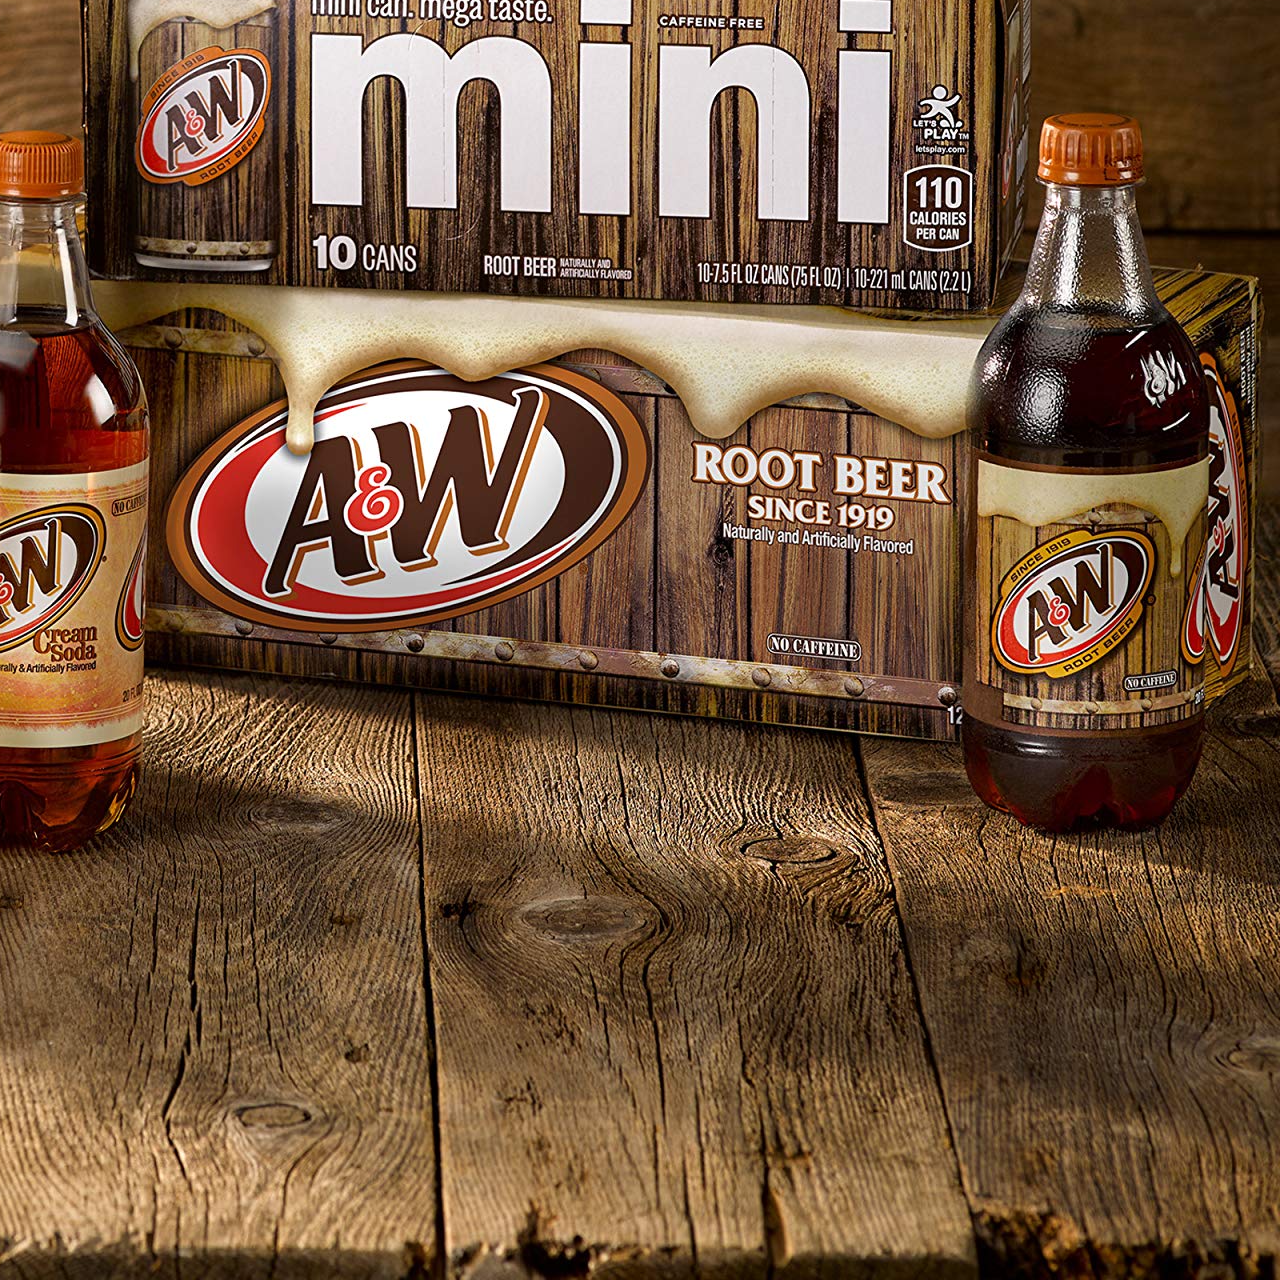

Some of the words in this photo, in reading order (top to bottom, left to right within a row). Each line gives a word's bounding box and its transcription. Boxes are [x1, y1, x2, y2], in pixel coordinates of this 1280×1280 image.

[659, 16, 726, 28] CAFFEINE
[729, 18, 764, 29] FREE
[150, 70, 179, 100] SINCE
[165, 58, 245, 173] A&W
[913, 119, 938, 128] LET'S
[199, 158, 231, 180] ROOT
[235, 130, 259, 159] BEER
[915, 145, 966, 155] letsplay.com
[915, 176, 963, 209] 110
[909, 210, 967, 226] CALORIES
[916, 227, 937, 240] PER
[939, 227, 960, 240] CAN
[312, 235, 357, 271] 10
[362, 245, 418, 272] CANS
[484, 255, 521, 276] ROOT
[523, 256, 557, 278] BEER
[559, 257, 596, 269] NATURALLY
[597, 258, 611, 269] AND
[559, 268, 600, 280] ARTIFICIALLY
[600, 269, 633, 281] FLAVORED
[697, 262, 730, 284] 10-7.5
[731, 264, 743, 285] FL
[745, 265, 759, 285] OZ
[761, 265, 789, 286] CANS
[791, 265, 809, 288] (75
[810, 266, 822, 287] FL
[824, 266, 842, 290] OZ)
[854, 267, 889, 290] 10-221
[891, 269, 907, 291] mL
[909, 270, 938, 292] CANS
[939, 271, 959, 294] (2.2
[961, 271, 971, 295] L)
[692, 441, 824, 494] ROOT
[832, 454, 952, 505] BEER
[261, 385, 550, 602] A&W
[113, 501, 125, 514] NO
[748, 495, 833, 527] SINCE
[836, 503, 897, 533] 1919
[722, 523, 774, 545] Naturally
[777, 528, 800, 545] and
[802, 530, 861, 554] Artificially
[863, 535, 914, 555] Flavored
[1010, 552, 1044, 583] SINCE
[1045, 537, 1072, 555] 1919
[1025, 542, 1117, 664] A&W
[32, 626, 98, 655] Cream
[51, 641, 98, 663] Soda
[770, 636, 790, 652] NO
[792, 638, 859, 659] CAFFEINE
[1063, 647, 1101, 673] ROOT
[1104, 617, 1135, 648] BEER
[19, 664, 26, 673] &
[26, 662, 65, 674] Artificially
[66, 660, 97, 672] Flavored
[1126, 677, 1139, 689] NO
[1140, 673, 1176, 688] CAFFEINE
[947, 704, 964, 726] 12
